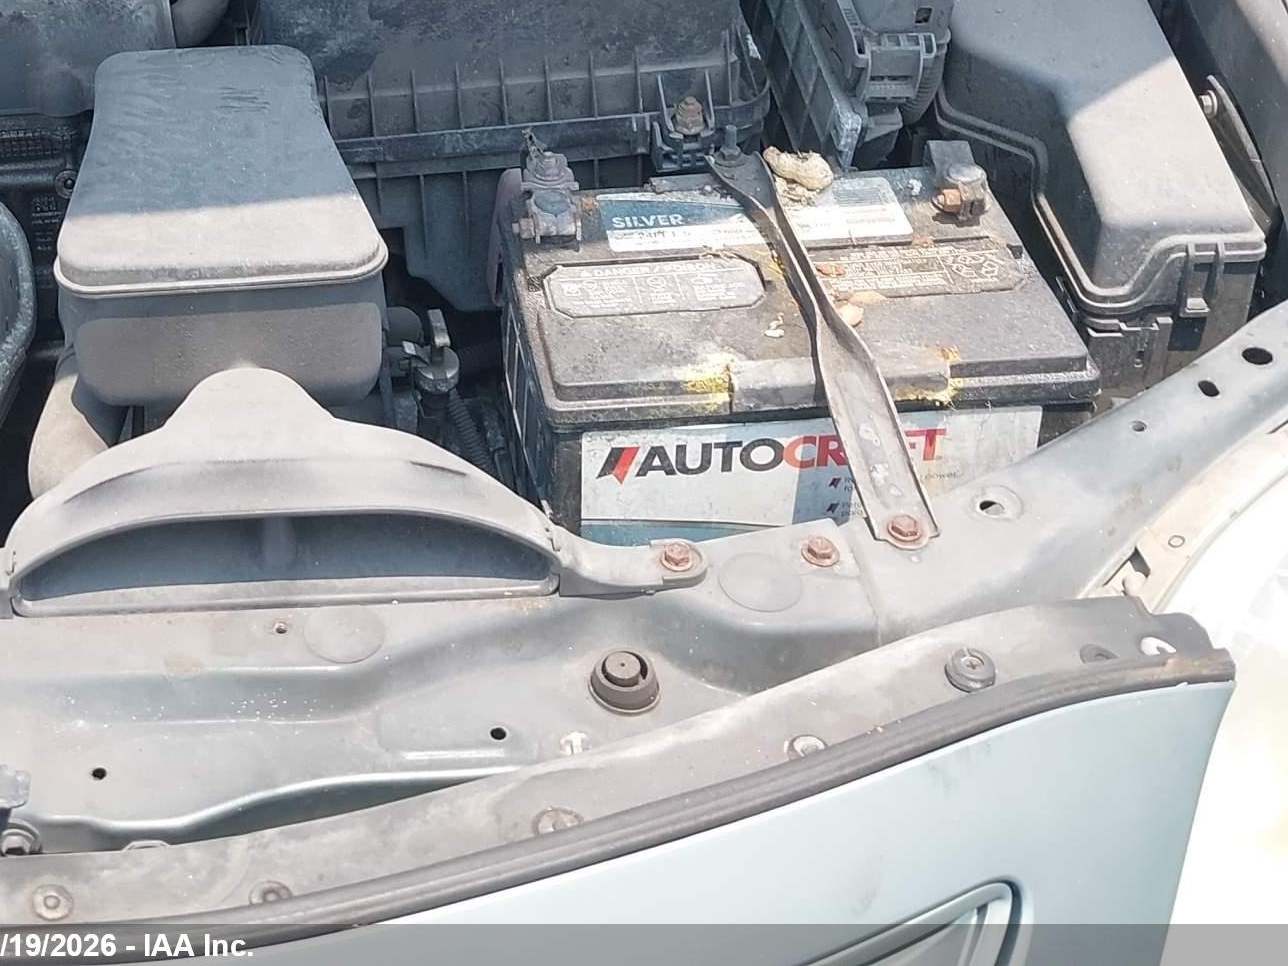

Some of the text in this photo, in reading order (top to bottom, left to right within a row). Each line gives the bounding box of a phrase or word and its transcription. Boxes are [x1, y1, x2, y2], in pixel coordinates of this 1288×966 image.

[612, 213, 684, 230] SILVER
[594, 265, 651, 277] DANGER
[664, 260, 716, 273] POISON
[635, 428, 947, 477] AUTOCRT
